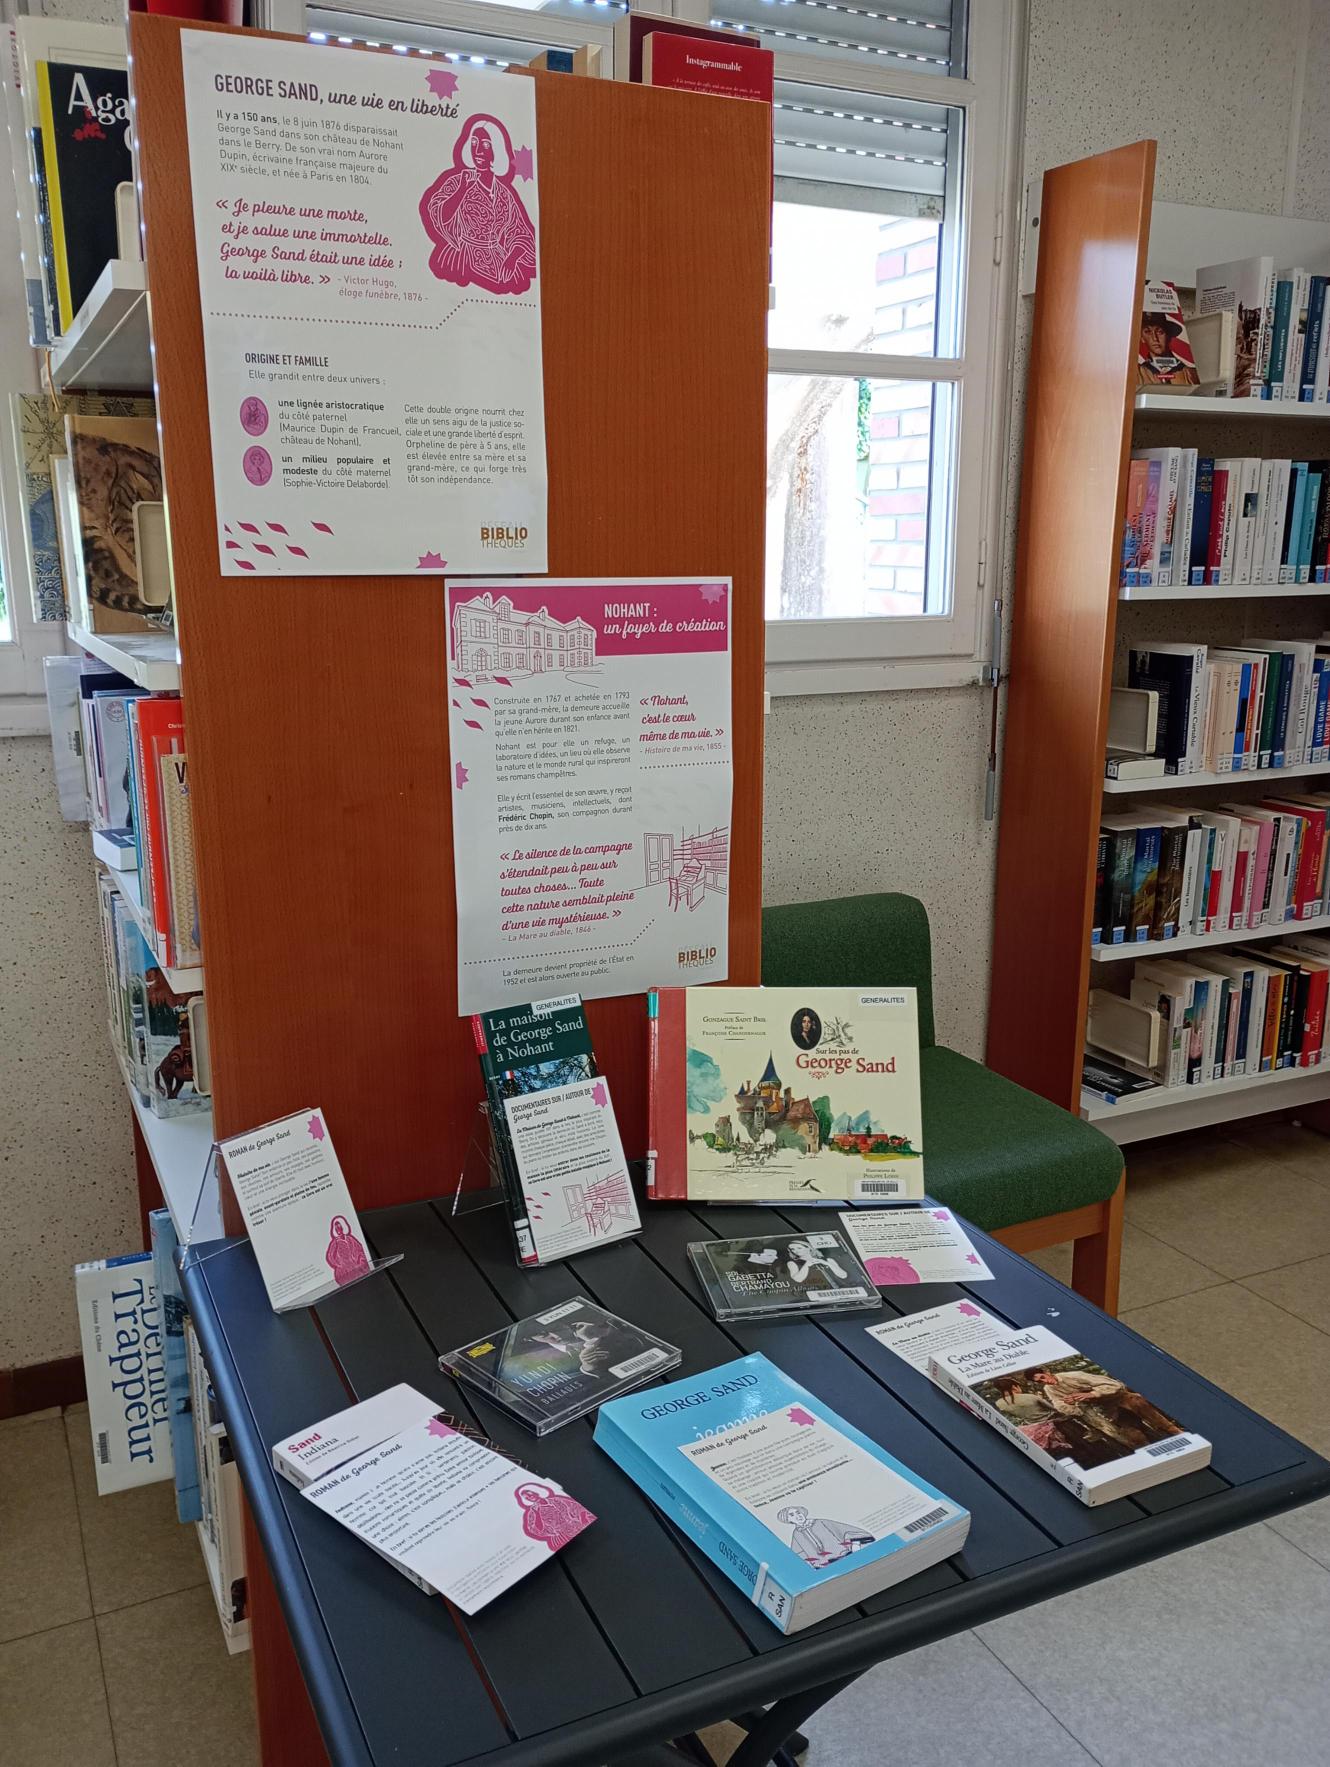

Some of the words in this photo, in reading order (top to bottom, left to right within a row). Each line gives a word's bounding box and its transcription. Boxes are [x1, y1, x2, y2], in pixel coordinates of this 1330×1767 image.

[685, 54, 744, 73] Instagrammable
[214, 74, 273, 96] GEORGE
[278, 80, 323, 104] SAND,
[328, 92, 357, 105] une
[361, 93, 383, 109] vie
[388, 99, 407, 112] en
[410, 98, 459, 118] liberté
[216, 109, 223, 118] Il
[225, 112, 230, 120] y
[242, 112, 258, 121] 150
[260, 115, 279, 125] ans,
[282, 116, 290, 125] le
[293, 117, 298, 125] 8
[321, 120, 340, 130] 1876
[343, 123, 397, 136] disparaissait
[232, 198, 249, 216] Je
[252, 201, 295, 216] pleure
[299, 208, 323, 218] une
[326, 209, 367, 224] morte,
[221, 221, 234, 236] et
[231, 223, 249, 240] je
[252, 224, 289, 237] salue
[293, 229, 317, 240] une
[320, 232, 393, 246] immortelle.
[220, 242, 267, 263] George
[271, 246, 307, 261] Sand
[309, 249, 339, 264] était
[342, 256, 365, 265] une
[368, 254, 394, 268] idée
[225, 266, 240, 279] la
[243, 268, 278, 281] voilà
[280, 269, 313, 284] libre.
[245, 353, 280, 364] ORIGINE
[282, 354, 291, 365] ET
[294, 355, 328, 367] FAMILLE
[248, 369, 265, 379] Elle
[268, 372, 299, 381] grandit
[302, 373, 324, 381] entre
[327, 373, 347, 382] deux
[296, 399, 323, 409] lignée
[325, 400, 384, 412] aristocratique
[480, 527, 528, 541] BIBLIO
[605, 603, 650, 617] NOHANT
[603, 624, 621, 634] un
[622, 620, 657, 639] foyer
[658, 619, 673, 632] de
[676, 618, 726, 632] création
[650, 695, 688, 706] Nohant,
[1318, 700, 1326, 721] GAME
[639, 731, 667, 741] même
[668, 730, 679, 739] de
[681, 731, 697, 739] ma
[697, 727, 712, 738] vie.
[498, 813, 526, 822] Frédéric
[529, 812, 554, 820] Chopin,
[511, 849, 523, 860] Le
[525, 849, 557, 859] silence
[559, 846, 571, 856] de
[572, 845, 583, 855] la
[584, 843, 632, 855] campagne
[499, 865, 549, 879] s'étendait
[549, 866, 570, 878] peu
[571, 862, 579, 872] à
[579, 863, 599, 875] peu
[600, 860, 618, 869] sur
[501, 885, 531, 896] toutes
[533, 883, 576, 893] choses...
[578, 877, 604, 888] Toute
[501, 903, 524, 913] cette
[526, 900, 560, 911] nature
[562, 894, 605, 907] semblait
[605, 892, 634, 905] pleine
[501, 920, 529, 930] d'une
[531, 917, 546, 927] vie
[548, 912, 609, 928] mystérieuse.
[677, 946, 717, 963] BIBLIO
[535, 996, 578, 1012] GENERALITES
[860, 996, 906, 1005] GENERALITES
[488, 1018, 507, 1032] La
[509, 1010, 554, 1028] maison
[492, 1033, 508, 1048] de
[510, 1026, 553, 1043] George
[554, 1016, 585, 1034] Sand
[496, 1050, 505, 1063] à
[506, 1041, 556, 1061] Nohant
[815, 1047, 828, 1055] Sur
[828, 1047, 838, 1055] les
[838, 1049, 850, 1057] pas
[795, 1053, 852, 1075] George
[855, 1056, 897, 1074] Sand
[510, 1097, 553, 1114] DOCUMENTAIRES
[551, 1094, 563, 1105] SUR
[565, 1089, 585, 1101] AUTOUR
[584, 1087, 592, 1097] DE
[513, 1111, 533, 1124] George
[533, 1107, 549, 1117] Sand
[228, 1145, 249, 1159] ROMAN
[248, 1144, 256, 1152] de
[256, 1136, 276, 1151] George
[275, 1129, 292, 1140] Sand
[727, 1271, 775, 1282] GABETTA
[732, 1280, 791, 1293] CHAMAYOU
[946, 1345, 997, 1366] George
[996, 1333, 1039, 1352] Sand
[108, 1278, 154, 1464] Trappeur
[957, 1365, 972, 1374] La
[971, 1359, 993, 1370] Mare
[1003, 1349, 1030, 1361] Diable
[511, 1362, 558, 1388] YUNDI
[526, 1371, 573, 1398] CHOPIN
[540, 1381, 584, 1405] BALLADES
[640, 1391, 712, 1420] GEORGE
[711, 1374, 759, 1398] SAND
[287, 1431, 323, 1454] Sand
[296, 1436, 340, 1461] Indiana
[690, 1443, 717, 1457] ROMAN
[725, 1432, 750, 1446] George
[748, 1424, 768, 1435] Sand
[309, 1478, 341, 1499] ROMAN
[340, 1473, 352, 1483] de
[351, 1457, 381, 1477] George
[379, 1443, 403, 1458] Sand
[718, 1540, 739, 1565] SAND
[767, 1591, 776, 1601] R
[775, 1594, 786, 1618] SAN
